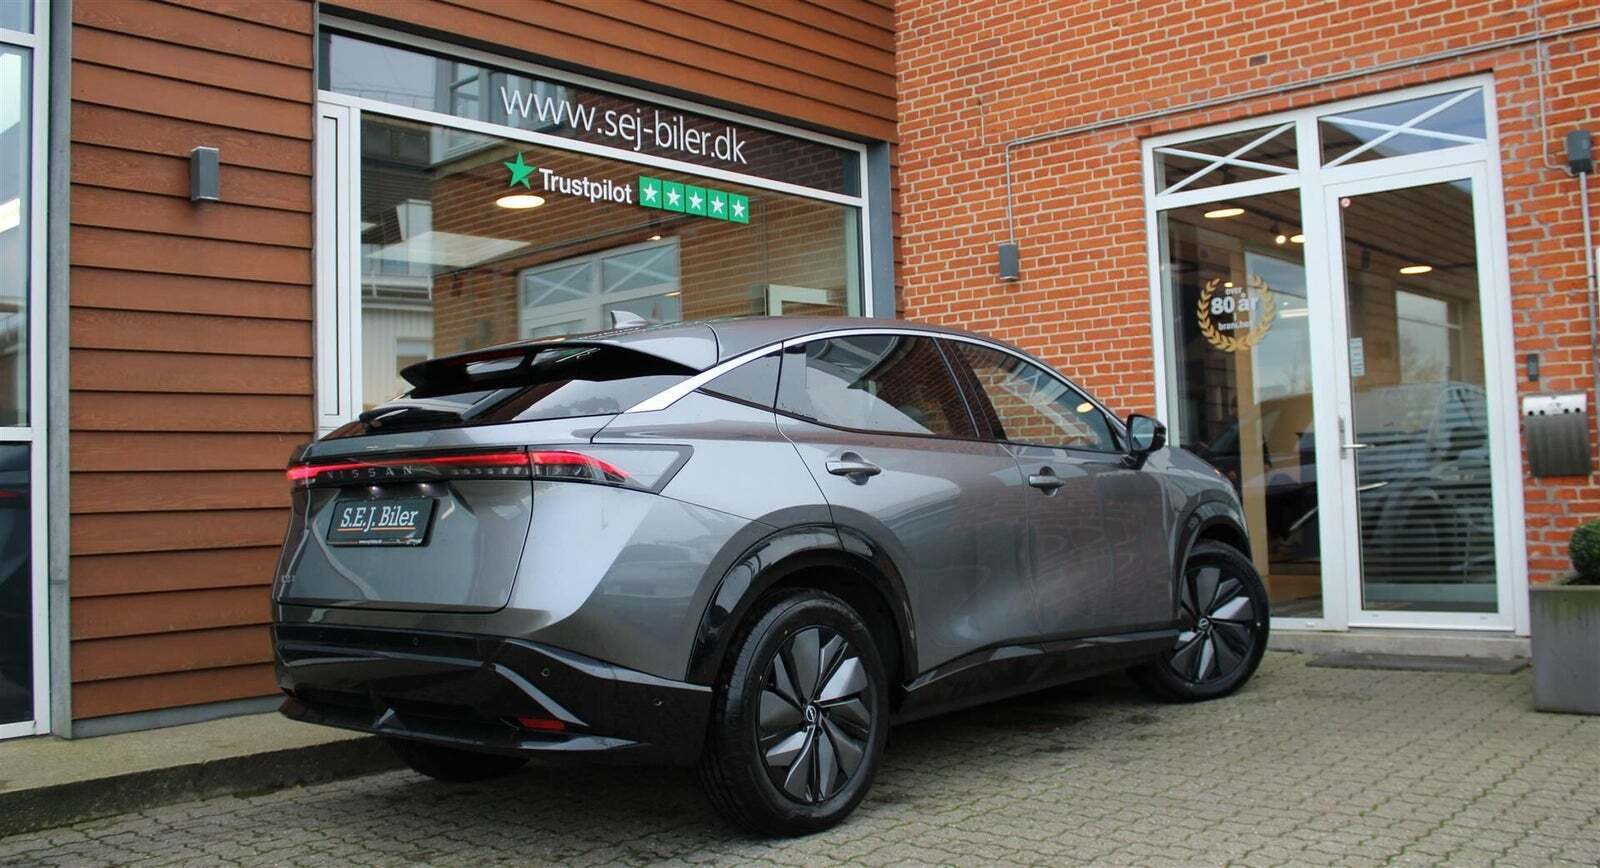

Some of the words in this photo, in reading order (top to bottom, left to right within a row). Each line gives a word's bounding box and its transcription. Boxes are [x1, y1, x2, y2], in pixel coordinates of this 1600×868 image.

[501, 87, 747, 164] www.sej-biler.dk
[539, 168, 633, 204] Trustpilot
[1211, 297, 1235, 314] 80
[1238, 293, 1259, 312] år
[327, 465, 413, 479] NISSAN
[341, 506, 375, 532] S.E.J.
[380, 505, 419, 527] Biler
